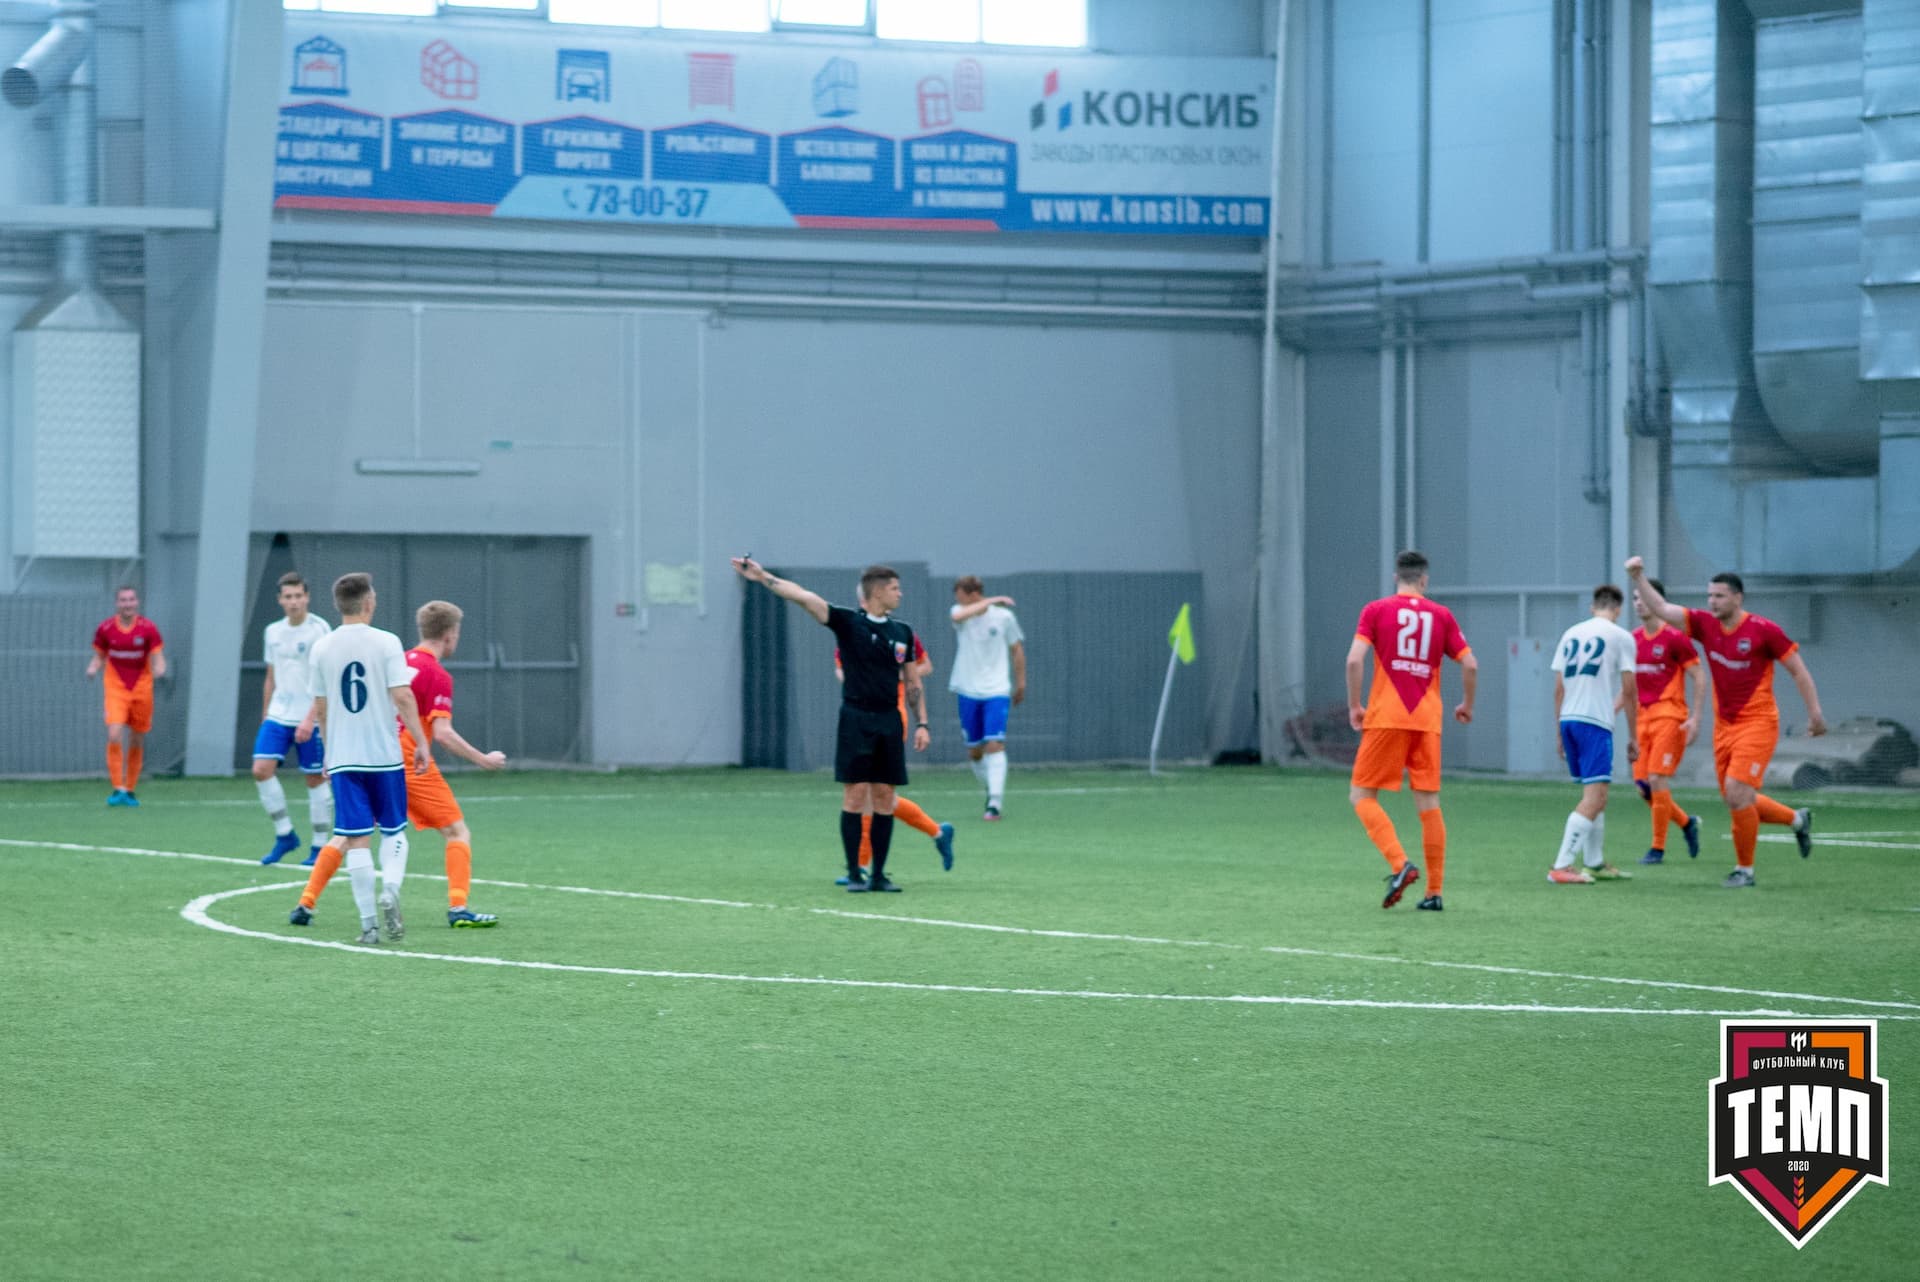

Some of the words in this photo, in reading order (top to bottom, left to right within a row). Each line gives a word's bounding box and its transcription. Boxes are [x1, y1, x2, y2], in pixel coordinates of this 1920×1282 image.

[1083, 91, 1260, 128] КОНСИБ
[586, 184, 709, 217] 73-00-37
[1031, 196, 1264, 226] www.konsib.com
[1397, 608, 1433, 661] 21
[1564, 636, 1605, 678] 22
[341, 661, 367, 713] 6
